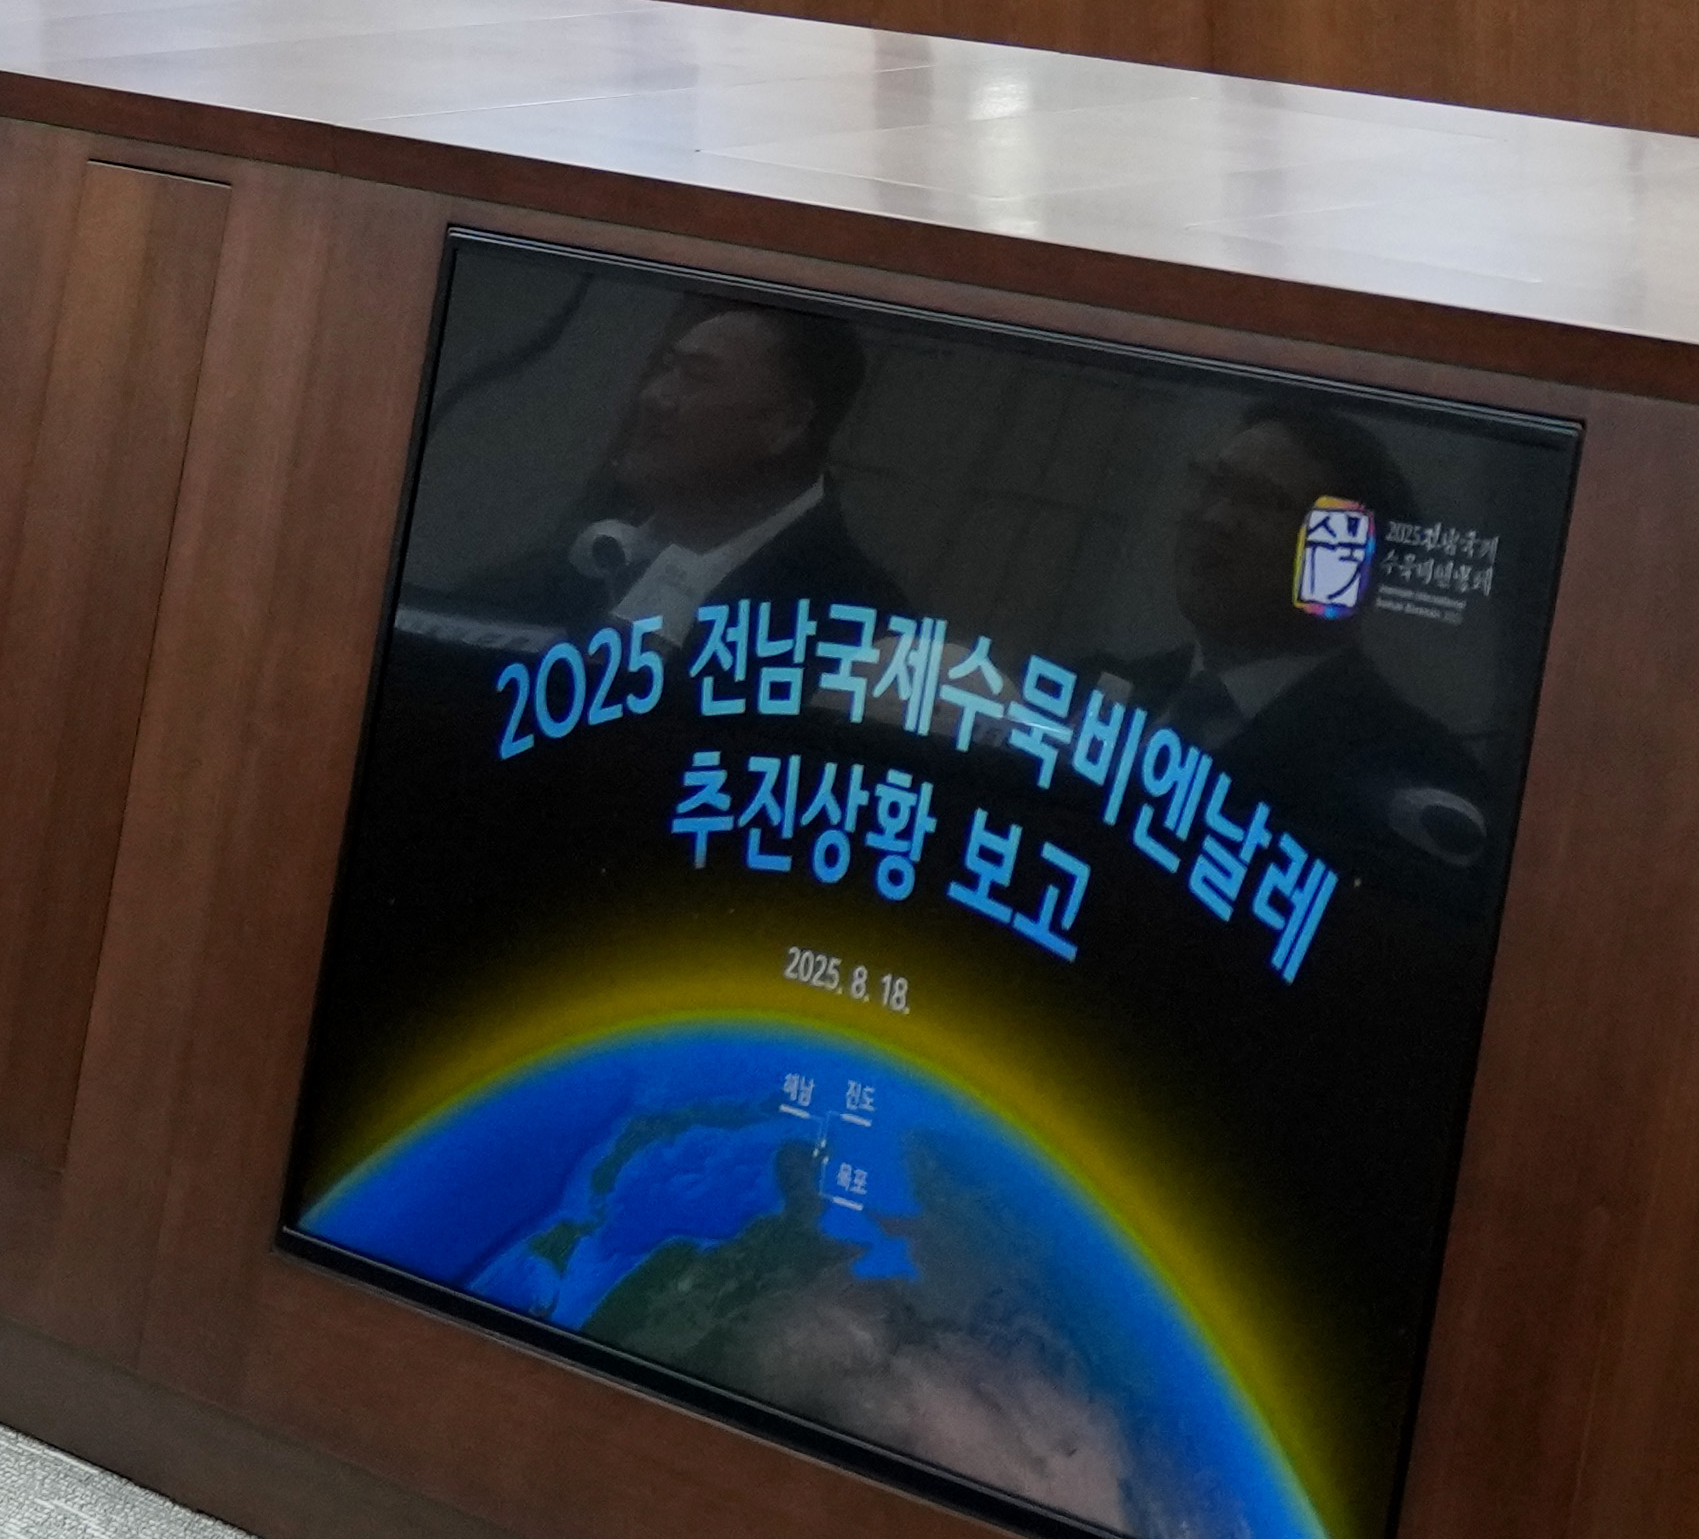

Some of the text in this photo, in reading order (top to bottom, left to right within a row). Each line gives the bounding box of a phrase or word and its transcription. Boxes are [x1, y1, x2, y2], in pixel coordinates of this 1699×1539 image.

[497, 599, 1337, 984] 2025 전남국제수묵비엔날레
[671, 751, 1091, 962] 추진상황 보고
